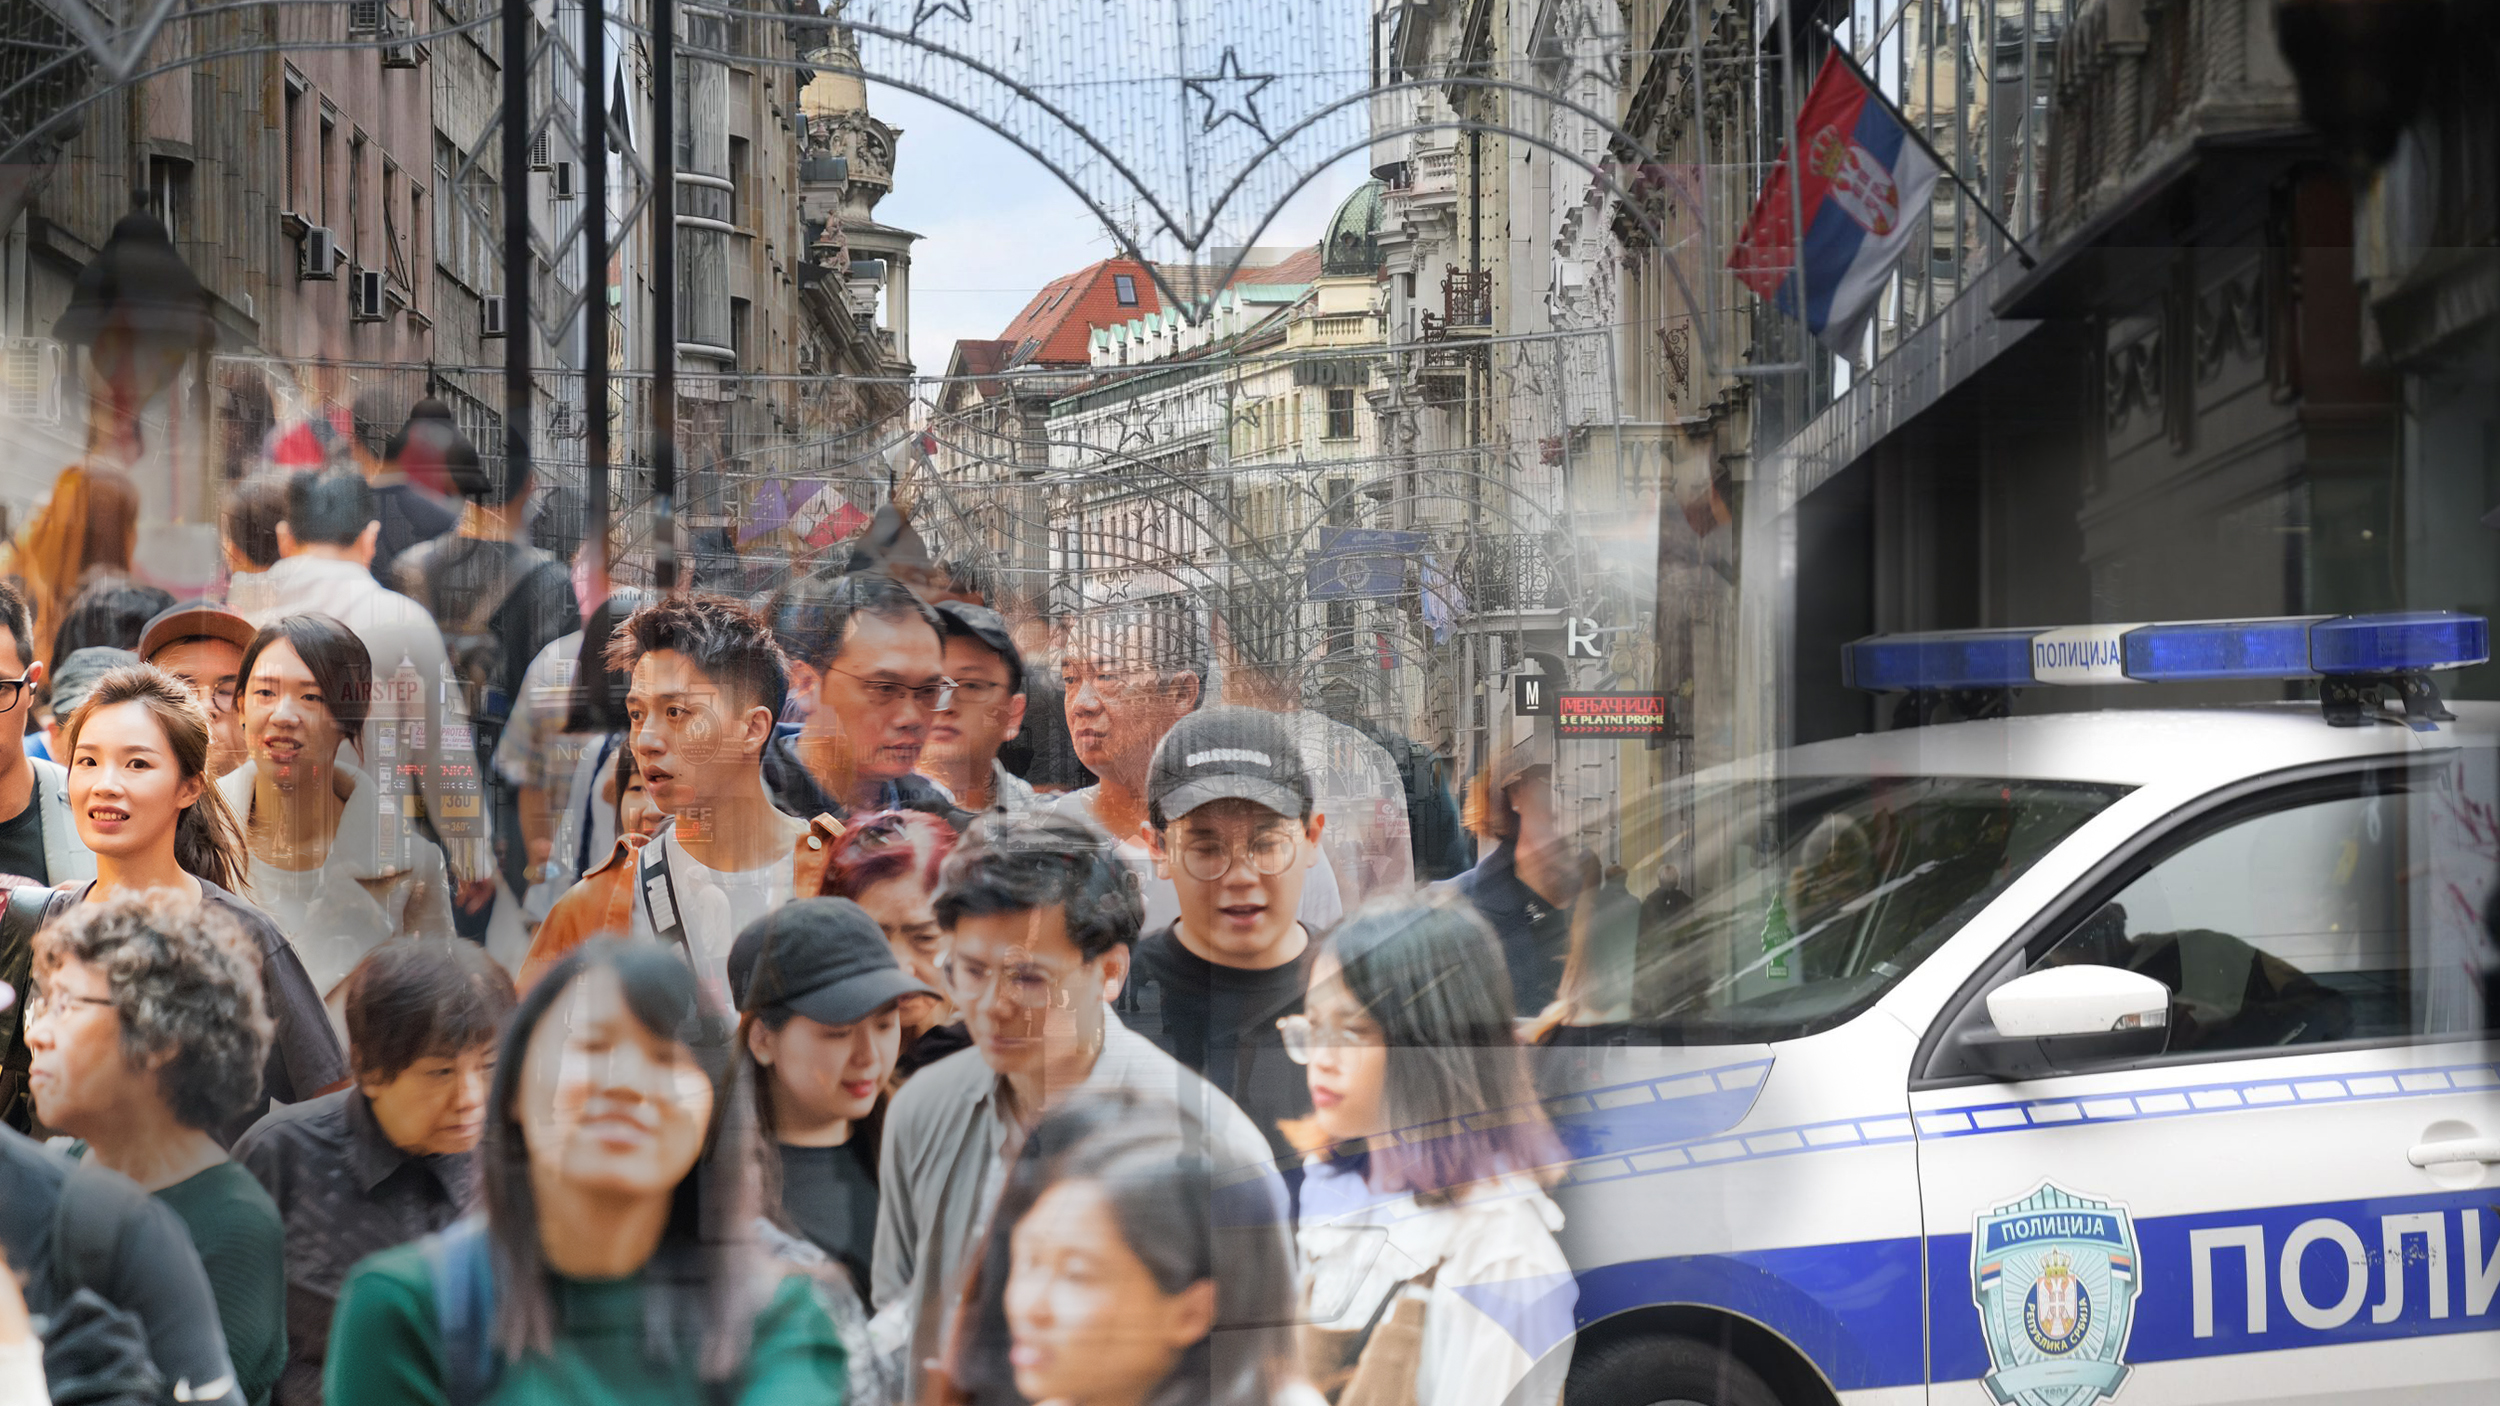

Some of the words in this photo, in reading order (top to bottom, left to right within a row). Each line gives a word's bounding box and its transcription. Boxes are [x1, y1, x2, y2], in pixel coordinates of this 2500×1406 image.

[2036, 640, 2121, 671] ПОЛИЦИЈА
[341, 681, 418, 702] AIRSTEP
[1564, 698, 1659, 713] МЕЊАЧНИЦА
[1581, 715, 1623, 725] PLATNI
[2001, 1216, 2105, 1242] ПОЛИЦИЈА
[2023, 1302, 2069, 1352] РЕПУБЛИКА
[2070, 1296, 2088, 1344] СРБИЈА
